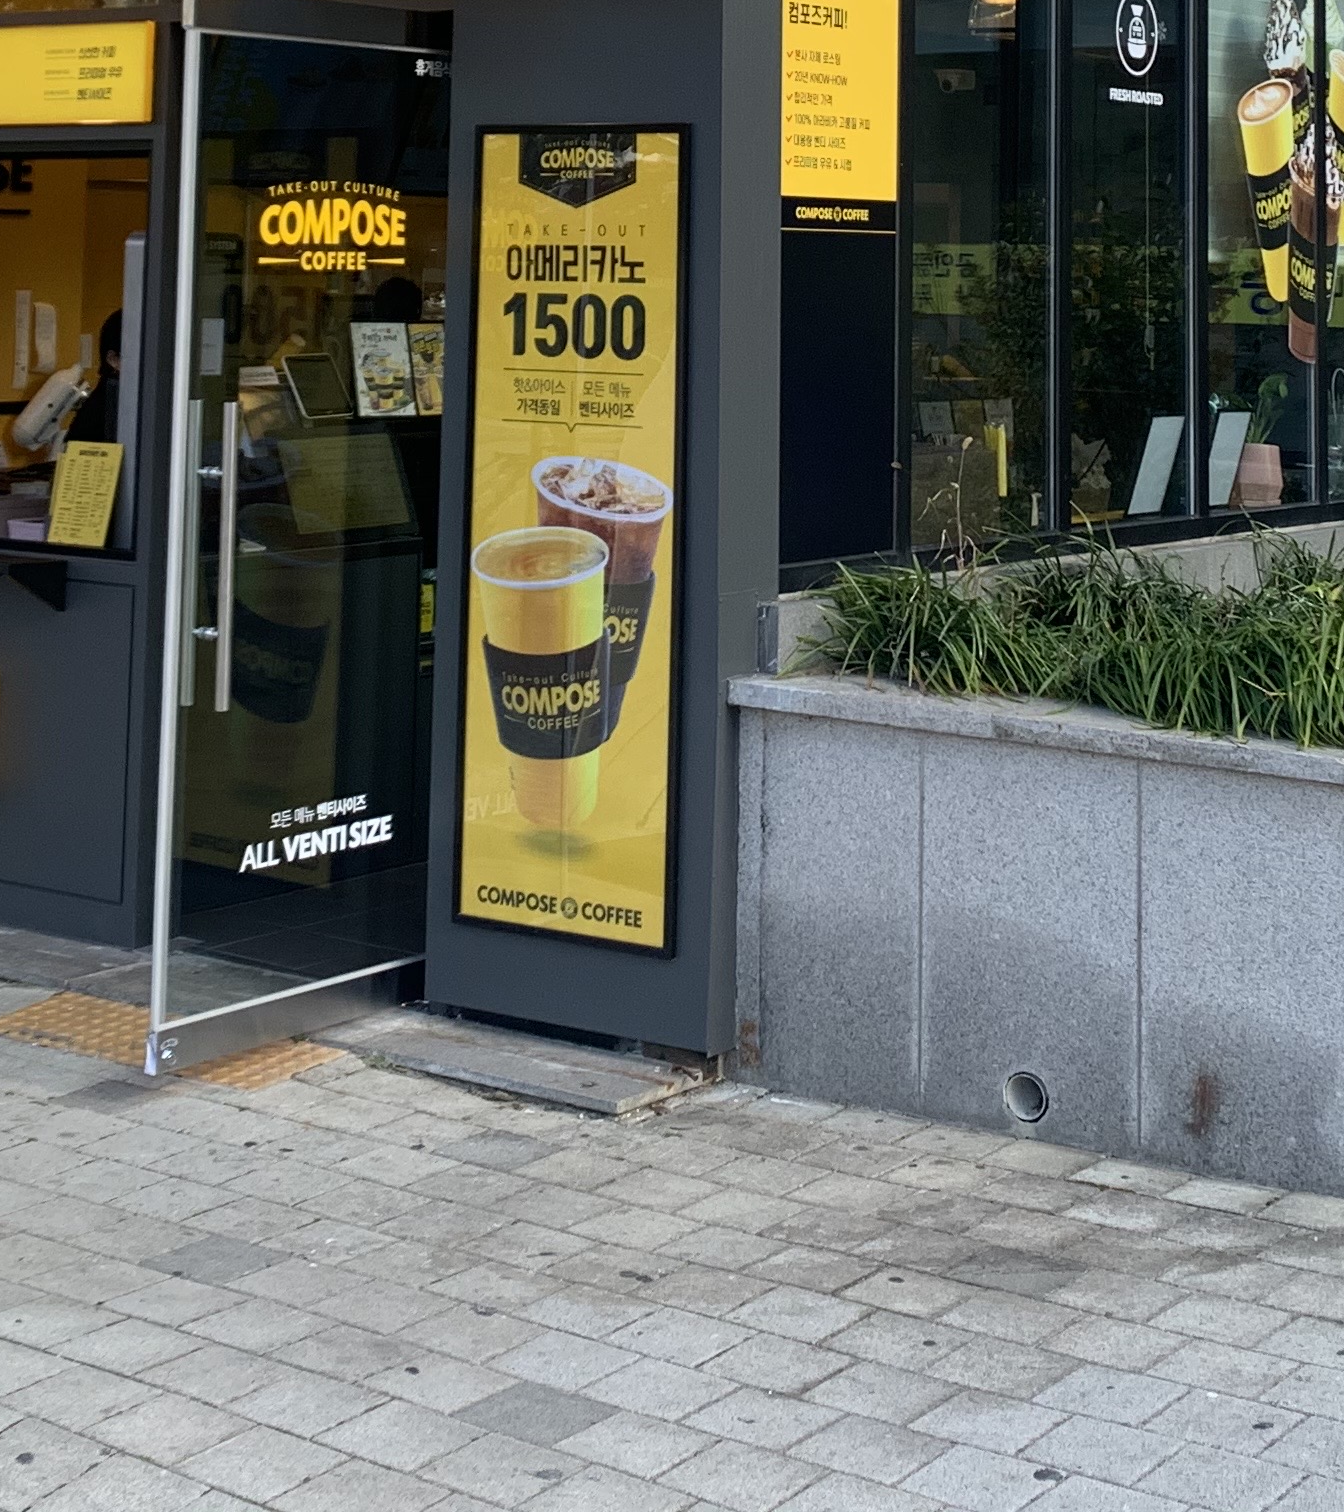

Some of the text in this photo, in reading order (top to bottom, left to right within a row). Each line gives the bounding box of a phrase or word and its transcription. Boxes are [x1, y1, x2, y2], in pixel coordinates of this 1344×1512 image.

[788, 1, 848, 29] 컴포즈커피!
[795, 71, 848, 86] 20년 KNOW-HOW
[1109, 87, 1164, 106] FRESH ROASTED
[794, 114, 811, 125] 100%
[540, 147, 615, 169] COMPOSE
[559, 170, 594, 179] COFFEE
[268, 180, 400, 202] TAKE-OUT CULTURE
[259, 197, 406, 247] COMPOSE
[795, 206, 869, 221] COMPOSE COFFEE
[506, 223, 647, 237] TAKE-OUT
[300, 251, 367, 271] COFFEE
[506, 245, 646, 284] 아메리카노
[503, 291, 646, 361] 1500
[582, 378, 605, 398] 모든
[516, 398, 635, 419] 가격동일 벤티사이즈
[501, 679, 600, 717] COMPOSE
[527, 714, 580, 730] COFFEE
[269, 793, 367, 828] 모든 메뉴 벤티사이즈
[239, 814, 394, 873] ALL VENTI SIZE
[476, 884, 642, 928] COMPOSE COFFEE
